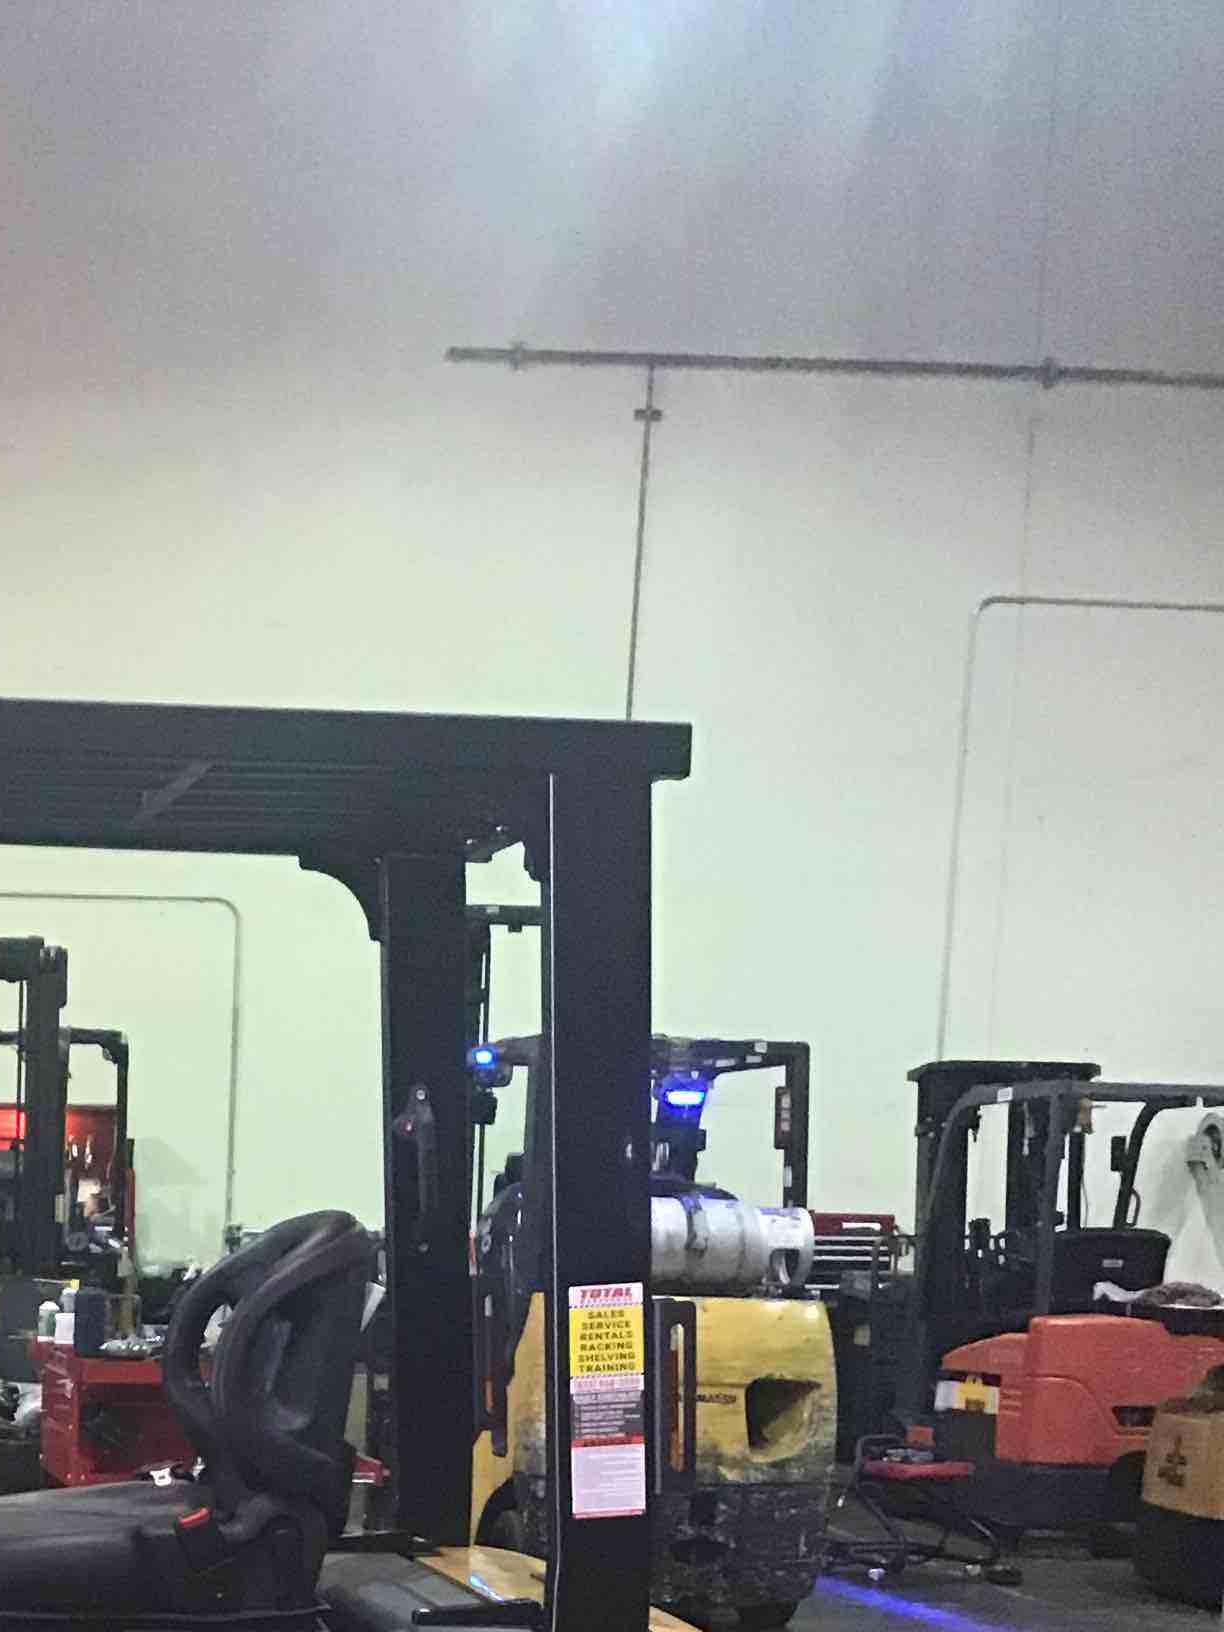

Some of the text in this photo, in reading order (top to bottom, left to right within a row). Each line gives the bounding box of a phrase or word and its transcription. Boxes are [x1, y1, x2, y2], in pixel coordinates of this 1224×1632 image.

[580, 1287, 633, 1298] TOTAL
[587, 1310, 625, 1319] SALES
[581, 1320, 632, 1331] SERVICE
[579, 1331, 633, 1341] RENTALS
[580, 1341, 633, 1351] RACKING
[578, 1352, 636, 1363] SHELVING
[579, 1363, 635, 1373] TRAINING
